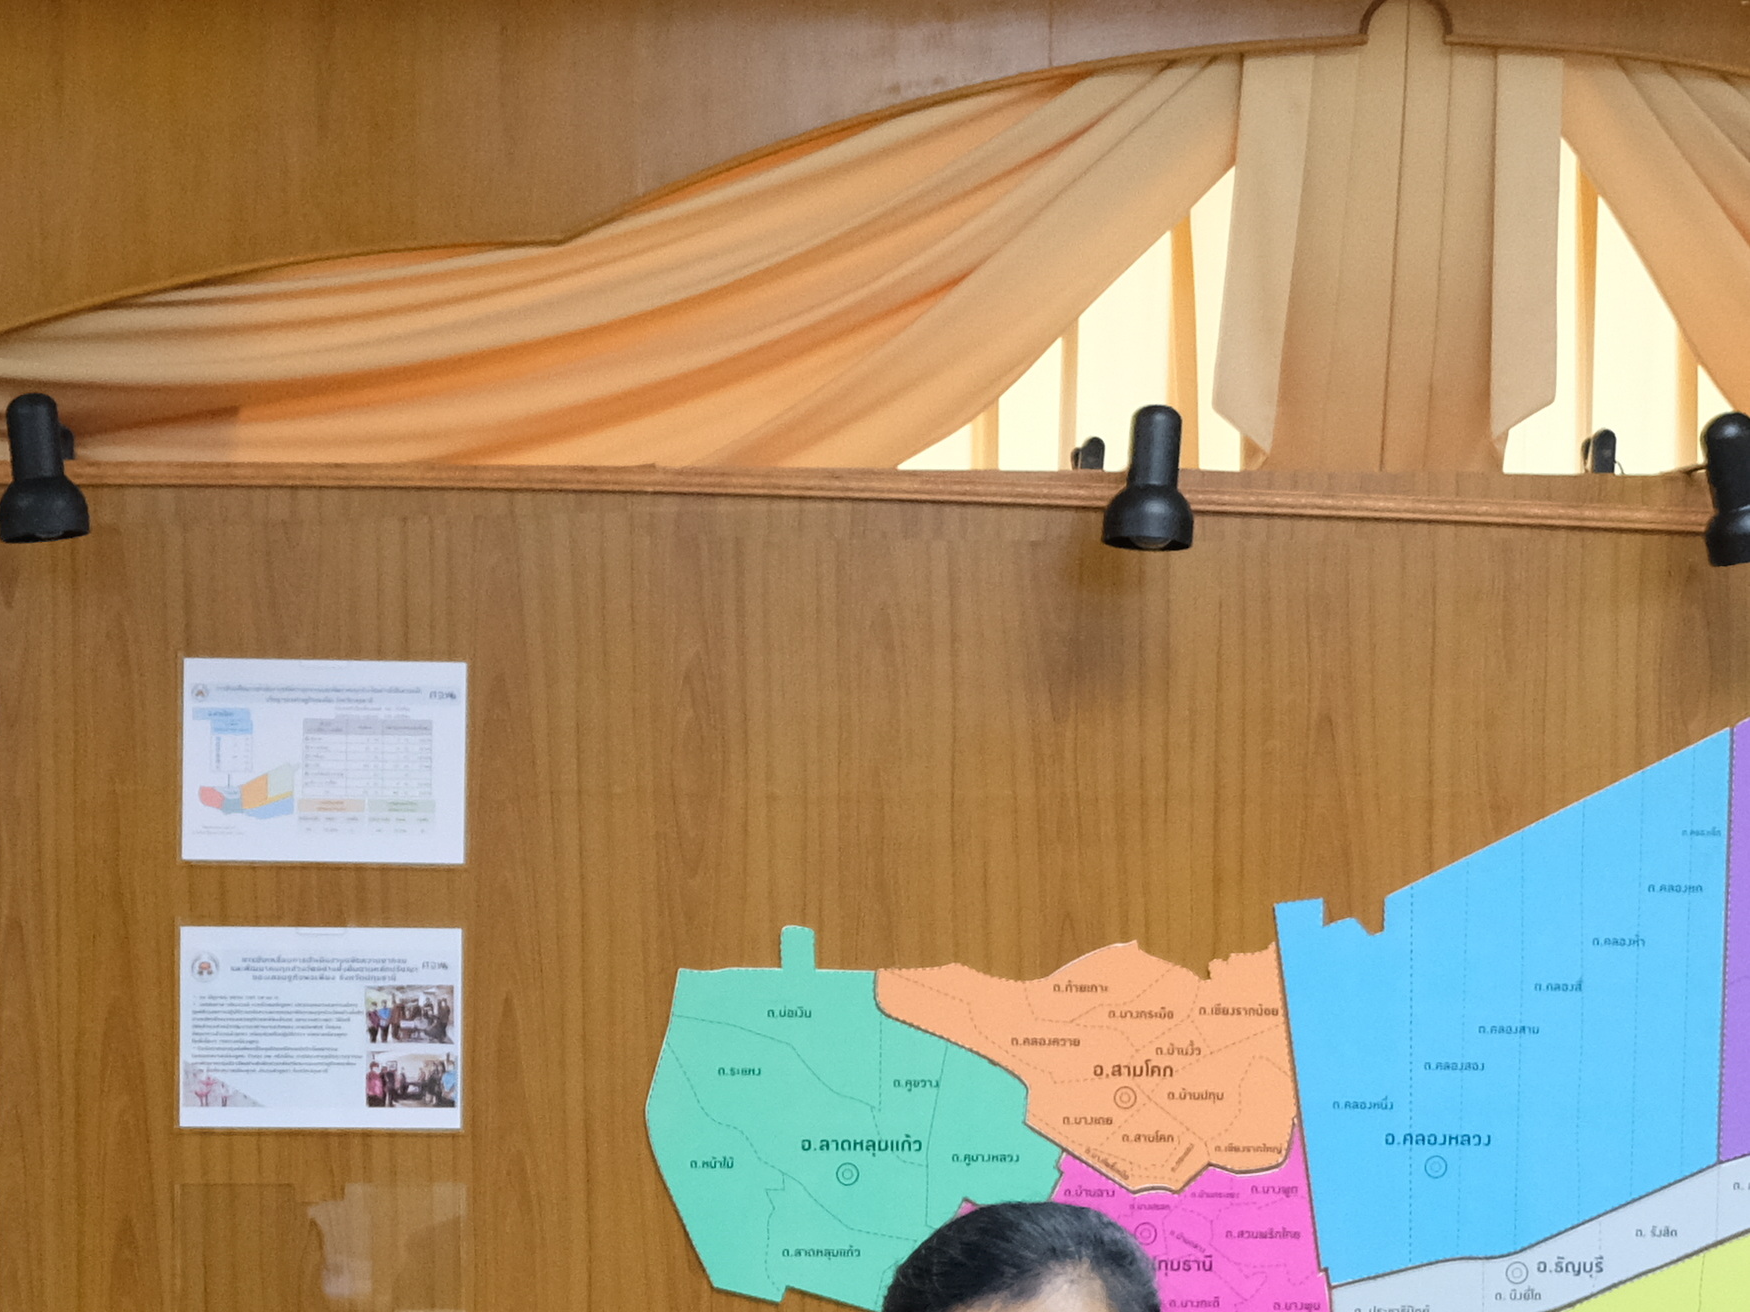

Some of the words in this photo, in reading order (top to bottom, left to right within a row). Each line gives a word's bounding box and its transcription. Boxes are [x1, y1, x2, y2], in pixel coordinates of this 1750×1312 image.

[1648, 883, 1703, 894] ต.คลองหก
[1591, 935, 1646, 948] ต.คลองห้า
[1534, 979, 1583, 993] ต.คลองสี่
[766, 1005, 812, 1019] ต.บ่อเงิน
[1108, 1007, 1174, 1020] ต.บางกระบือ
[1199, 1006, 1278, 1016] ต.เชียงรากน้อย
[1479, 1024, 1540, 1035] ต.คลองสาม
[1011, 1037, 1080, 1047] ต.คลองควาย
[718, 1066, 762, 1077] ต.ระแหง
[1094, 1060, 1174, 1078] อ.สามโคก
[1424, 1061, 1485, 1072] ต.คลองสอง
[893, 1077, 940, 1092] ต.คูขวาง
[1168, 1090, 1224, 1104] ต.บ้านปทุม
[1332, 1096, 1394, 1111] ต.คลองหนึ่ง
[1062, 1116, 1112, 1126] ต.บางเตย
[1122, 1132, 1174, 1143] ต.สามโคก
[1384, 1132, 1491, 1147] อ.คลองหลวง
[801, 1136, 922, 1158] อ.ลาดหลุมแก้ว
[690, 1157, 735, 1171] ต.หน้าไม้
[952, 1152, 1019, 1168] ต.คูบางหลวง
[1650, 1226, 1678, 1238] รังสิต
[782, 1244, 861, 1260] ต.ลาดหลุมแก้ว
[1537, 1255, 1604, 1278] อ.ธัญบุรี
